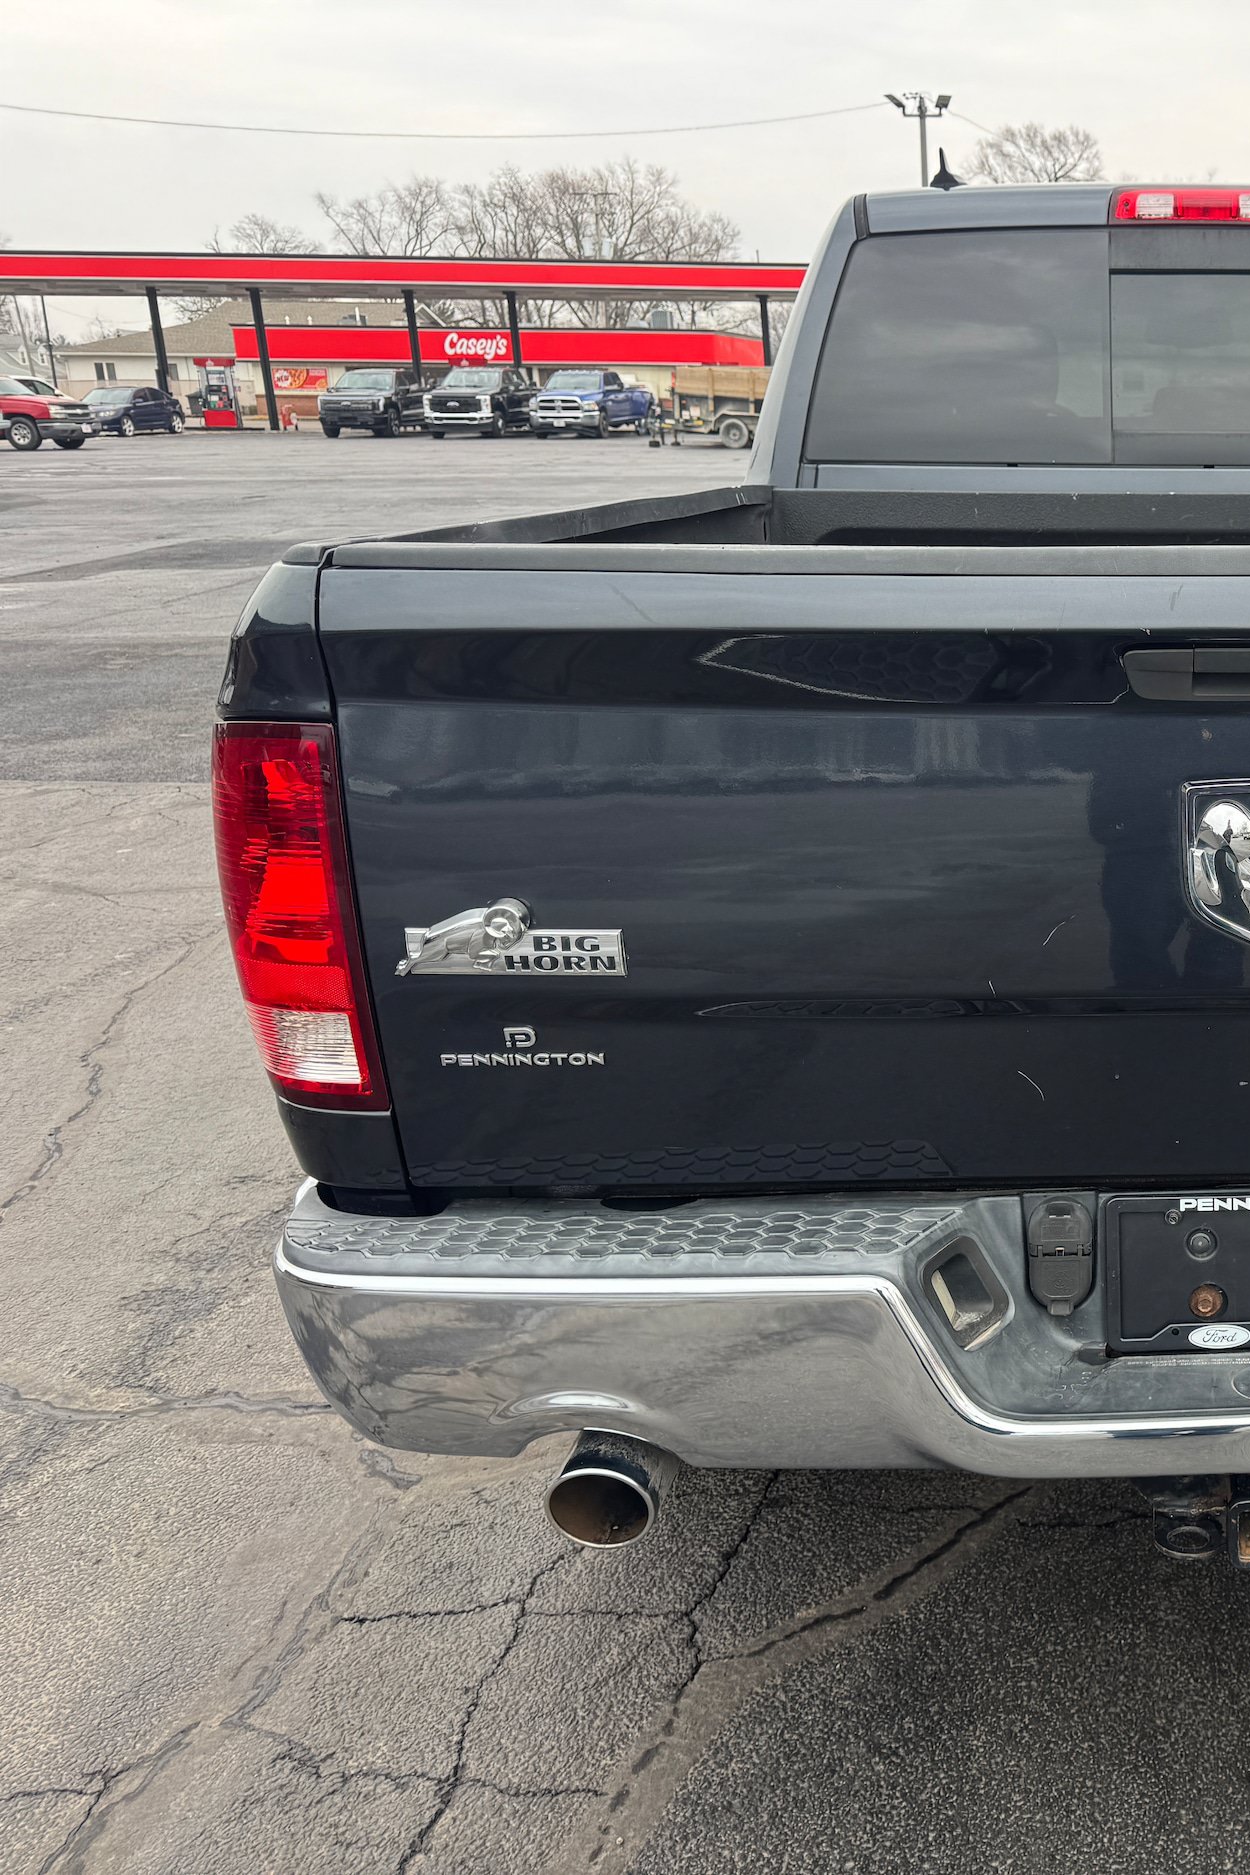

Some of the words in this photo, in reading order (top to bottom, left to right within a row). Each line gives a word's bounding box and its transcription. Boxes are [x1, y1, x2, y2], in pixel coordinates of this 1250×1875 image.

[444, 332, 508, 360] Casey's
[532, 935, 601, 953] BIG
[504, 955, 618, 973] HORN
[439, 1051, 606, 1067] PENNINGTON
[1202, 1329, 1237, 1343] Ford
